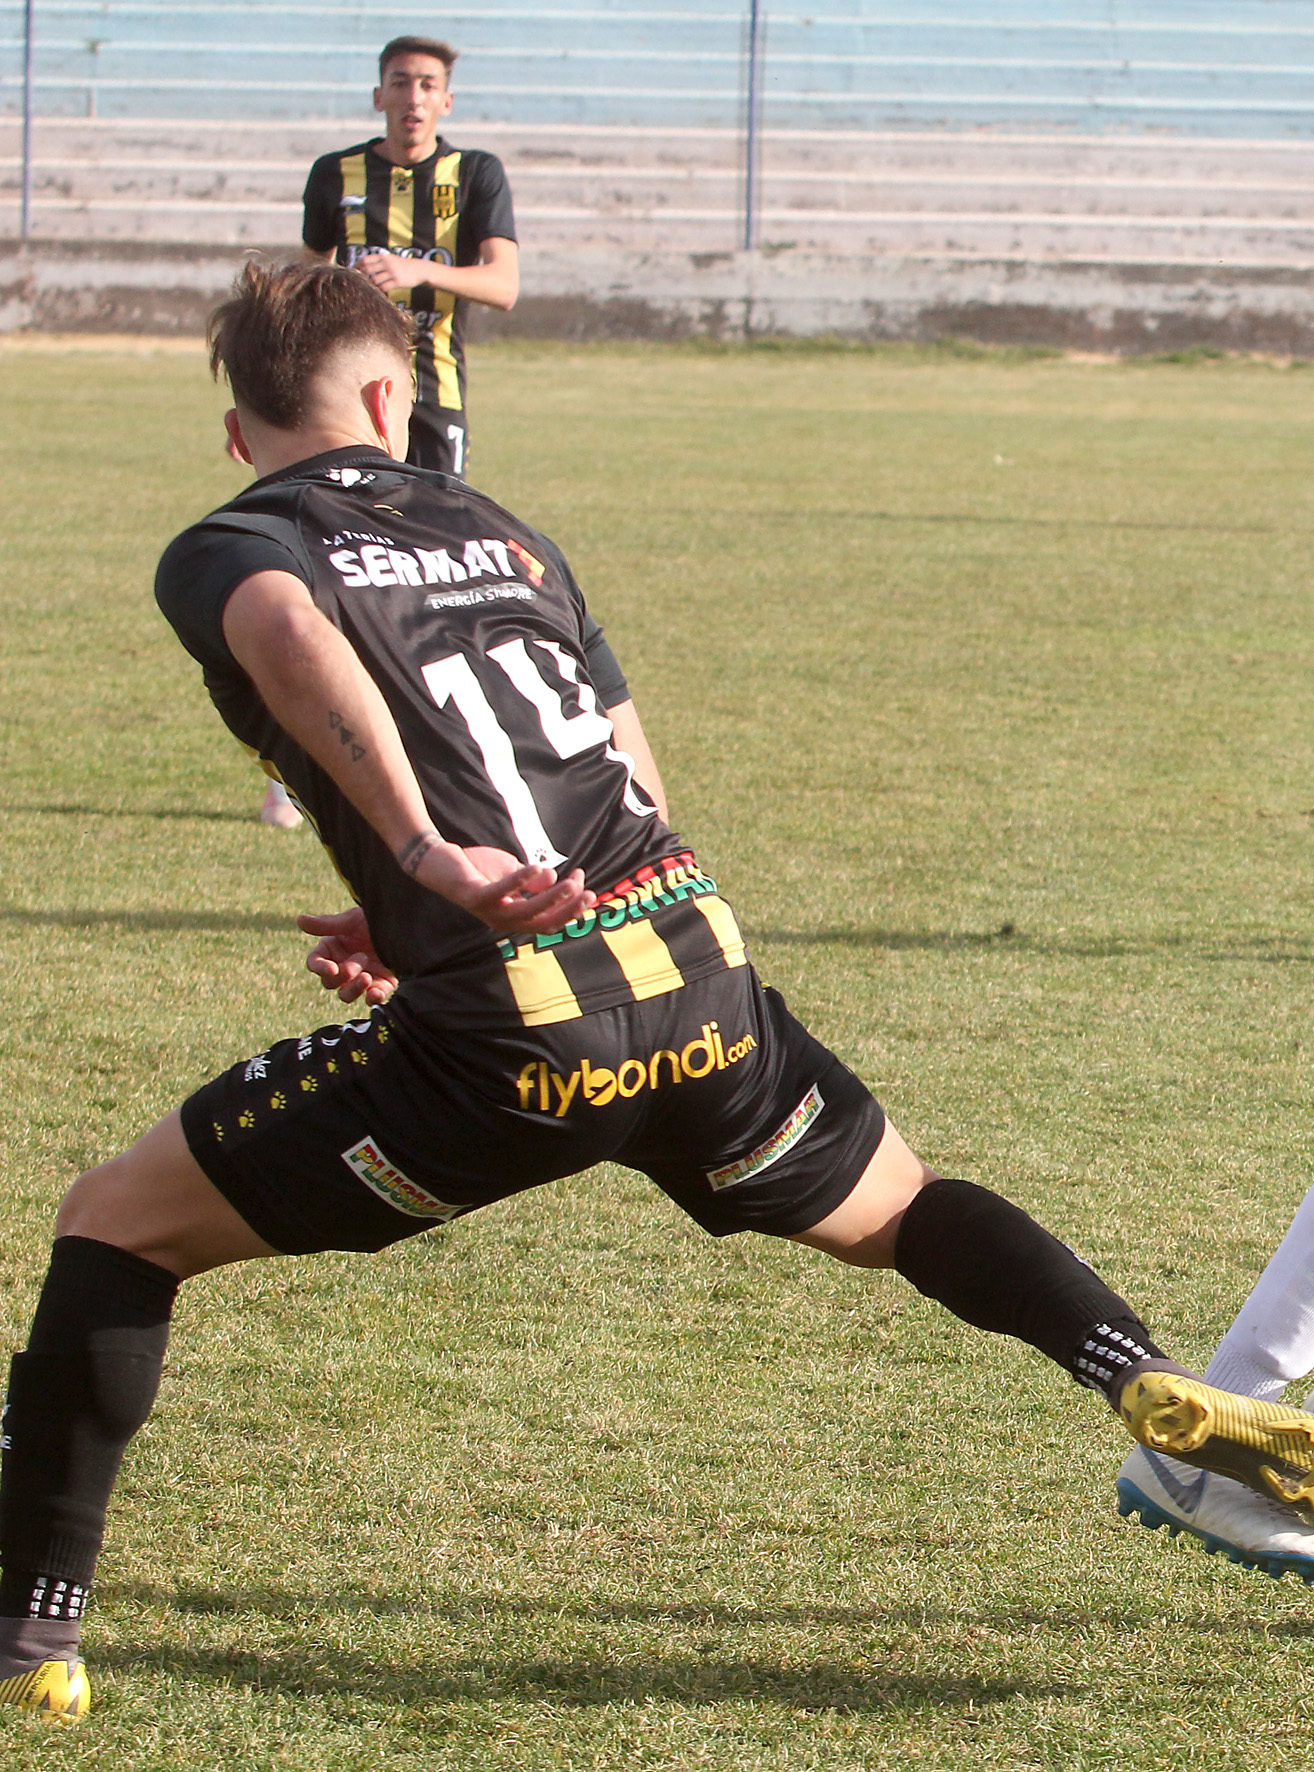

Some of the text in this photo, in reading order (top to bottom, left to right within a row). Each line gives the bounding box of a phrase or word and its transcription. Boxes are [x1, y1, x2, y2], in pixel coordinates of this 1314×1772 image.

[328, 538, 517, 588] SERMAT
[430, 590, 485, 610] ENERGÍA
[420, 636, 660, 870] 14
[713, 1092, 820, 1187] PLUSMAR
